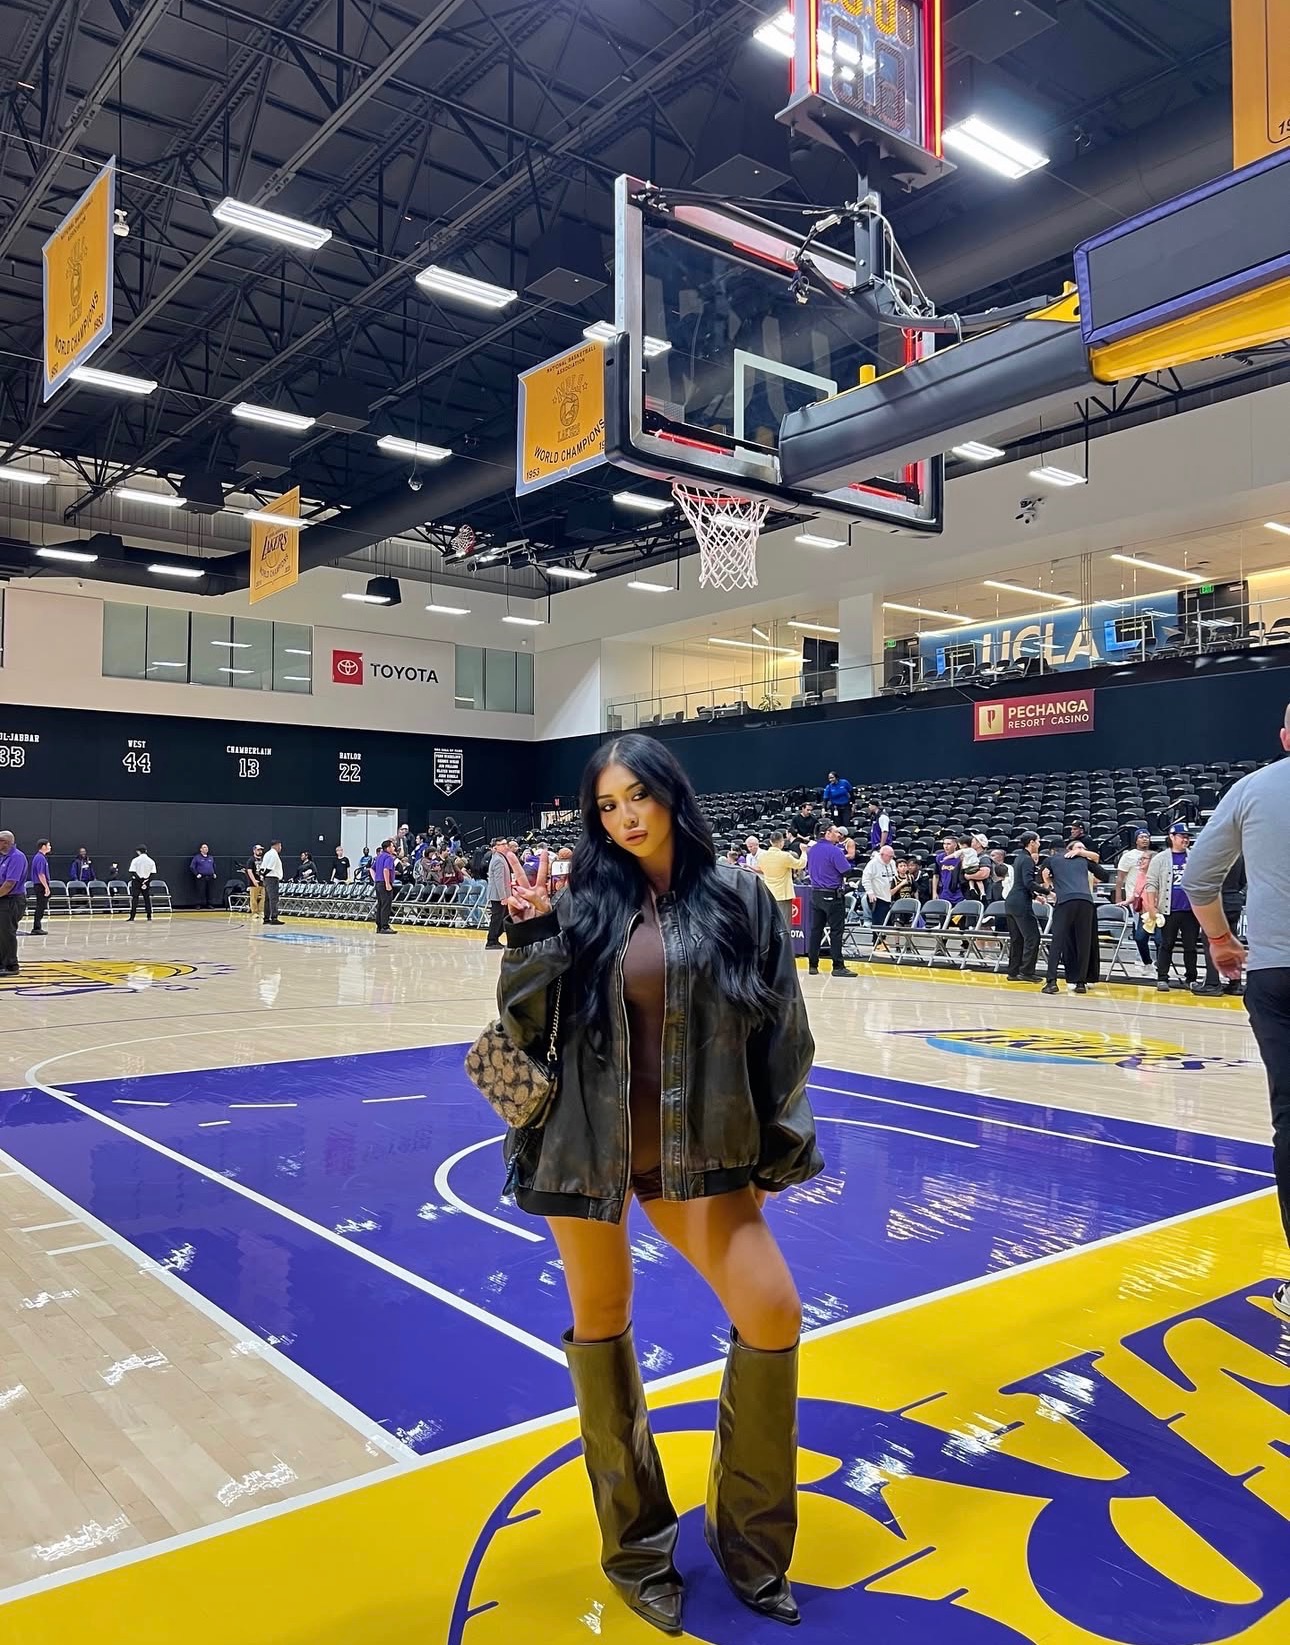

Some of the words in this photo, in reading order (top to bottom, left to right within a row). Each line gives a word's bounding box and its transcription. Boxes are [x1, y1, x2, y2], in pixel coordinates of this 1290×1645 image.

[534, 445, 559, 464] WORLD
[561, 418, 605, 461] CHAMPIONS
[982, 616, 1100, 665] UCLA
[370, 663, 439, 683] TOYOTA
[1008, 699, 1089, 719] PECHANGA
[1008, 717, 1046, 729] RESORT
[1050, 713, 1090, 725] CASINO
[127, 739, 147, 749] WEST
[226, 745, 272, 756] CHAMBERLAIN
[0, 745, 25, 768] 33
[122, 751, 151, 774] 44
[239, 757, 260, 778] 13
[339, 763, 361, 783] 22
